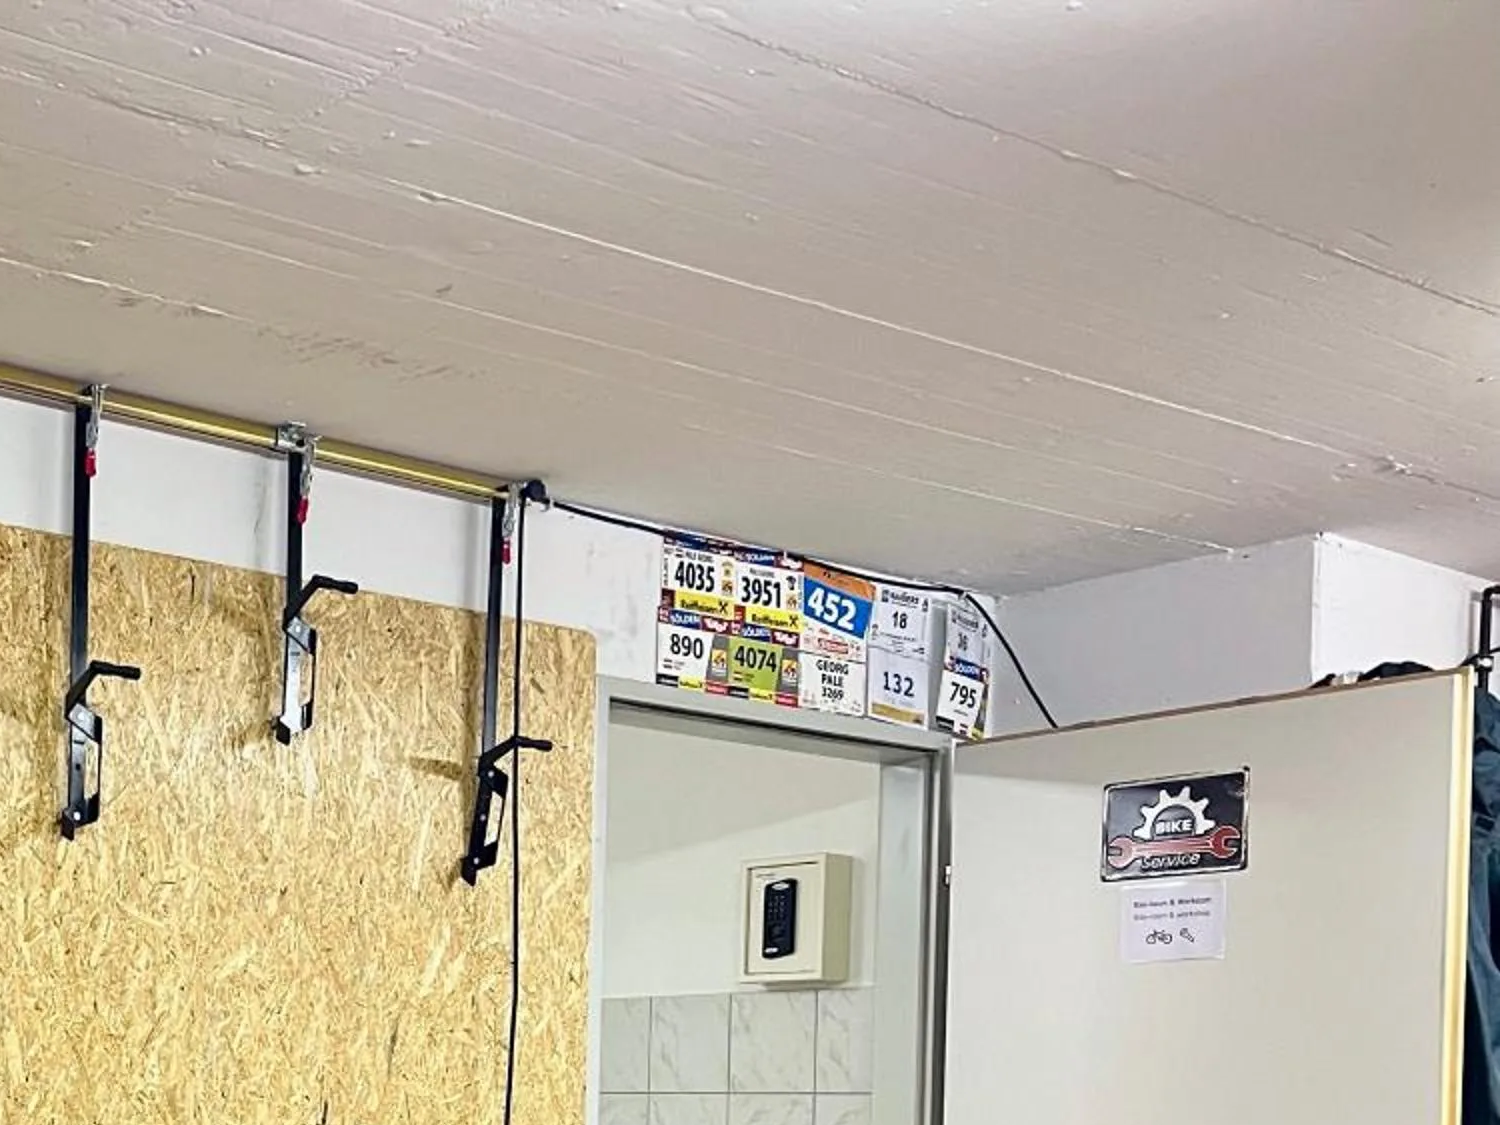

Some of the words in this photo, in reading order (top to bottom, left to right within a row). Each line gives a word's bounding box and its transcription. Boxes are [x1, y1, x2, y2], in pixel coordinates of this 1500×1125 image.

[675, 561, 714, 592] 4035
[741, 576, 780, 608] 3951
[807, 586, 856, 631] 452
[892, 611, 908, 629] 18
[670, 633, 704, 659] 890
[734, 645, 777, 673] 4074
[816, 659, 849, 675] GEORG
[883, 671, 915, 698] 132
[950, 681, 977, 709] 795
[1155, 819, 1193, 835] BIKE
